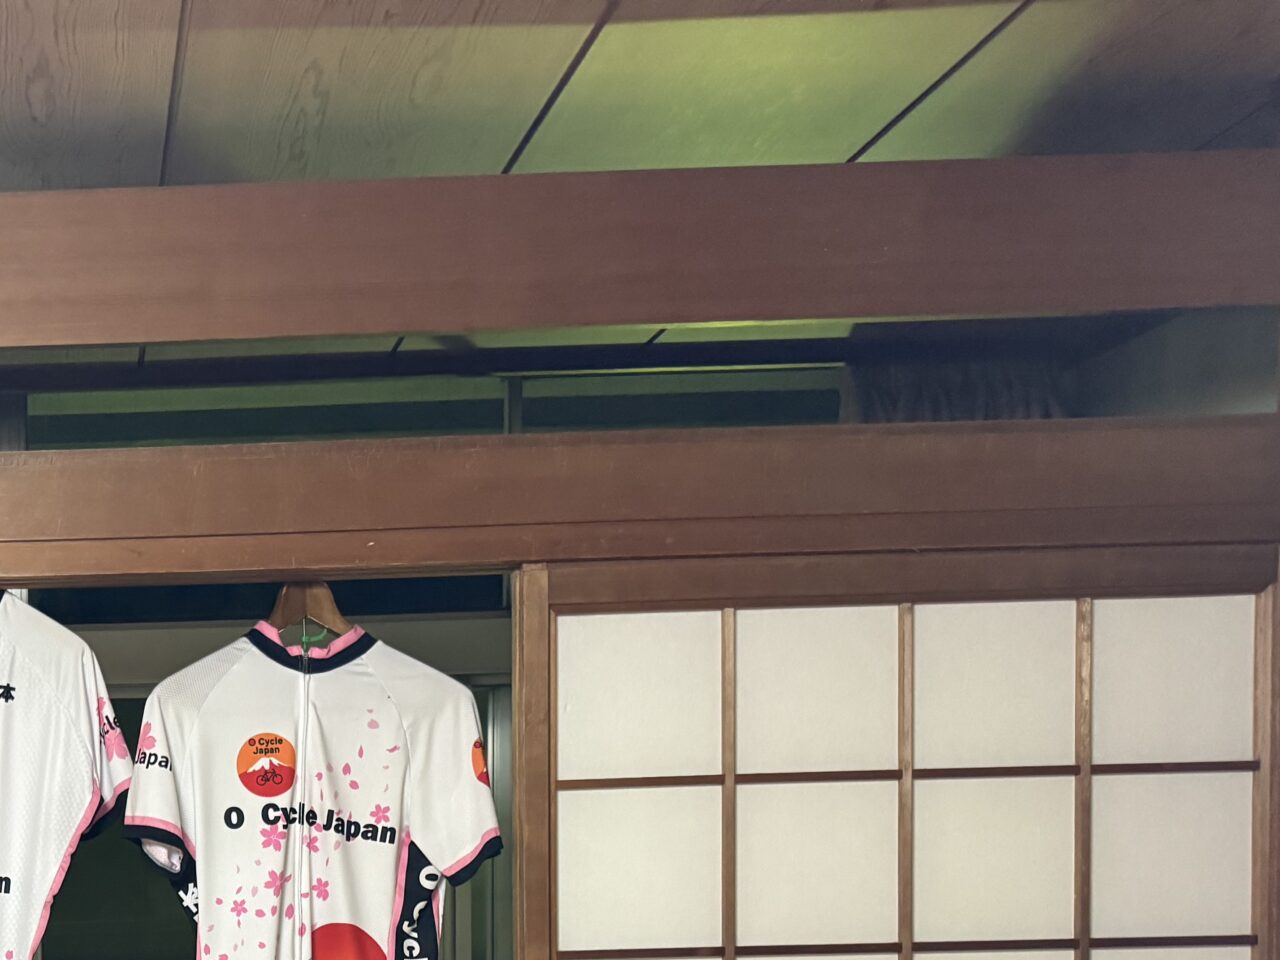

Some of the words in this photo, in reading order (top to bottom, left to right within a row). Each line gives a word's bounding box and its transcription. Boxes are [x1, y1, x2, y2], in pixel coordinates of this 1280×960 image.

[252, 746, 280, 756] Japan
[257, 736, 284, 748] Cycle
[223, 806, 245, 830] O
[261, 801, 318, 830] Cycle
[322, 809, 397, 845] Japan
[419, 864, 442, 891] O
